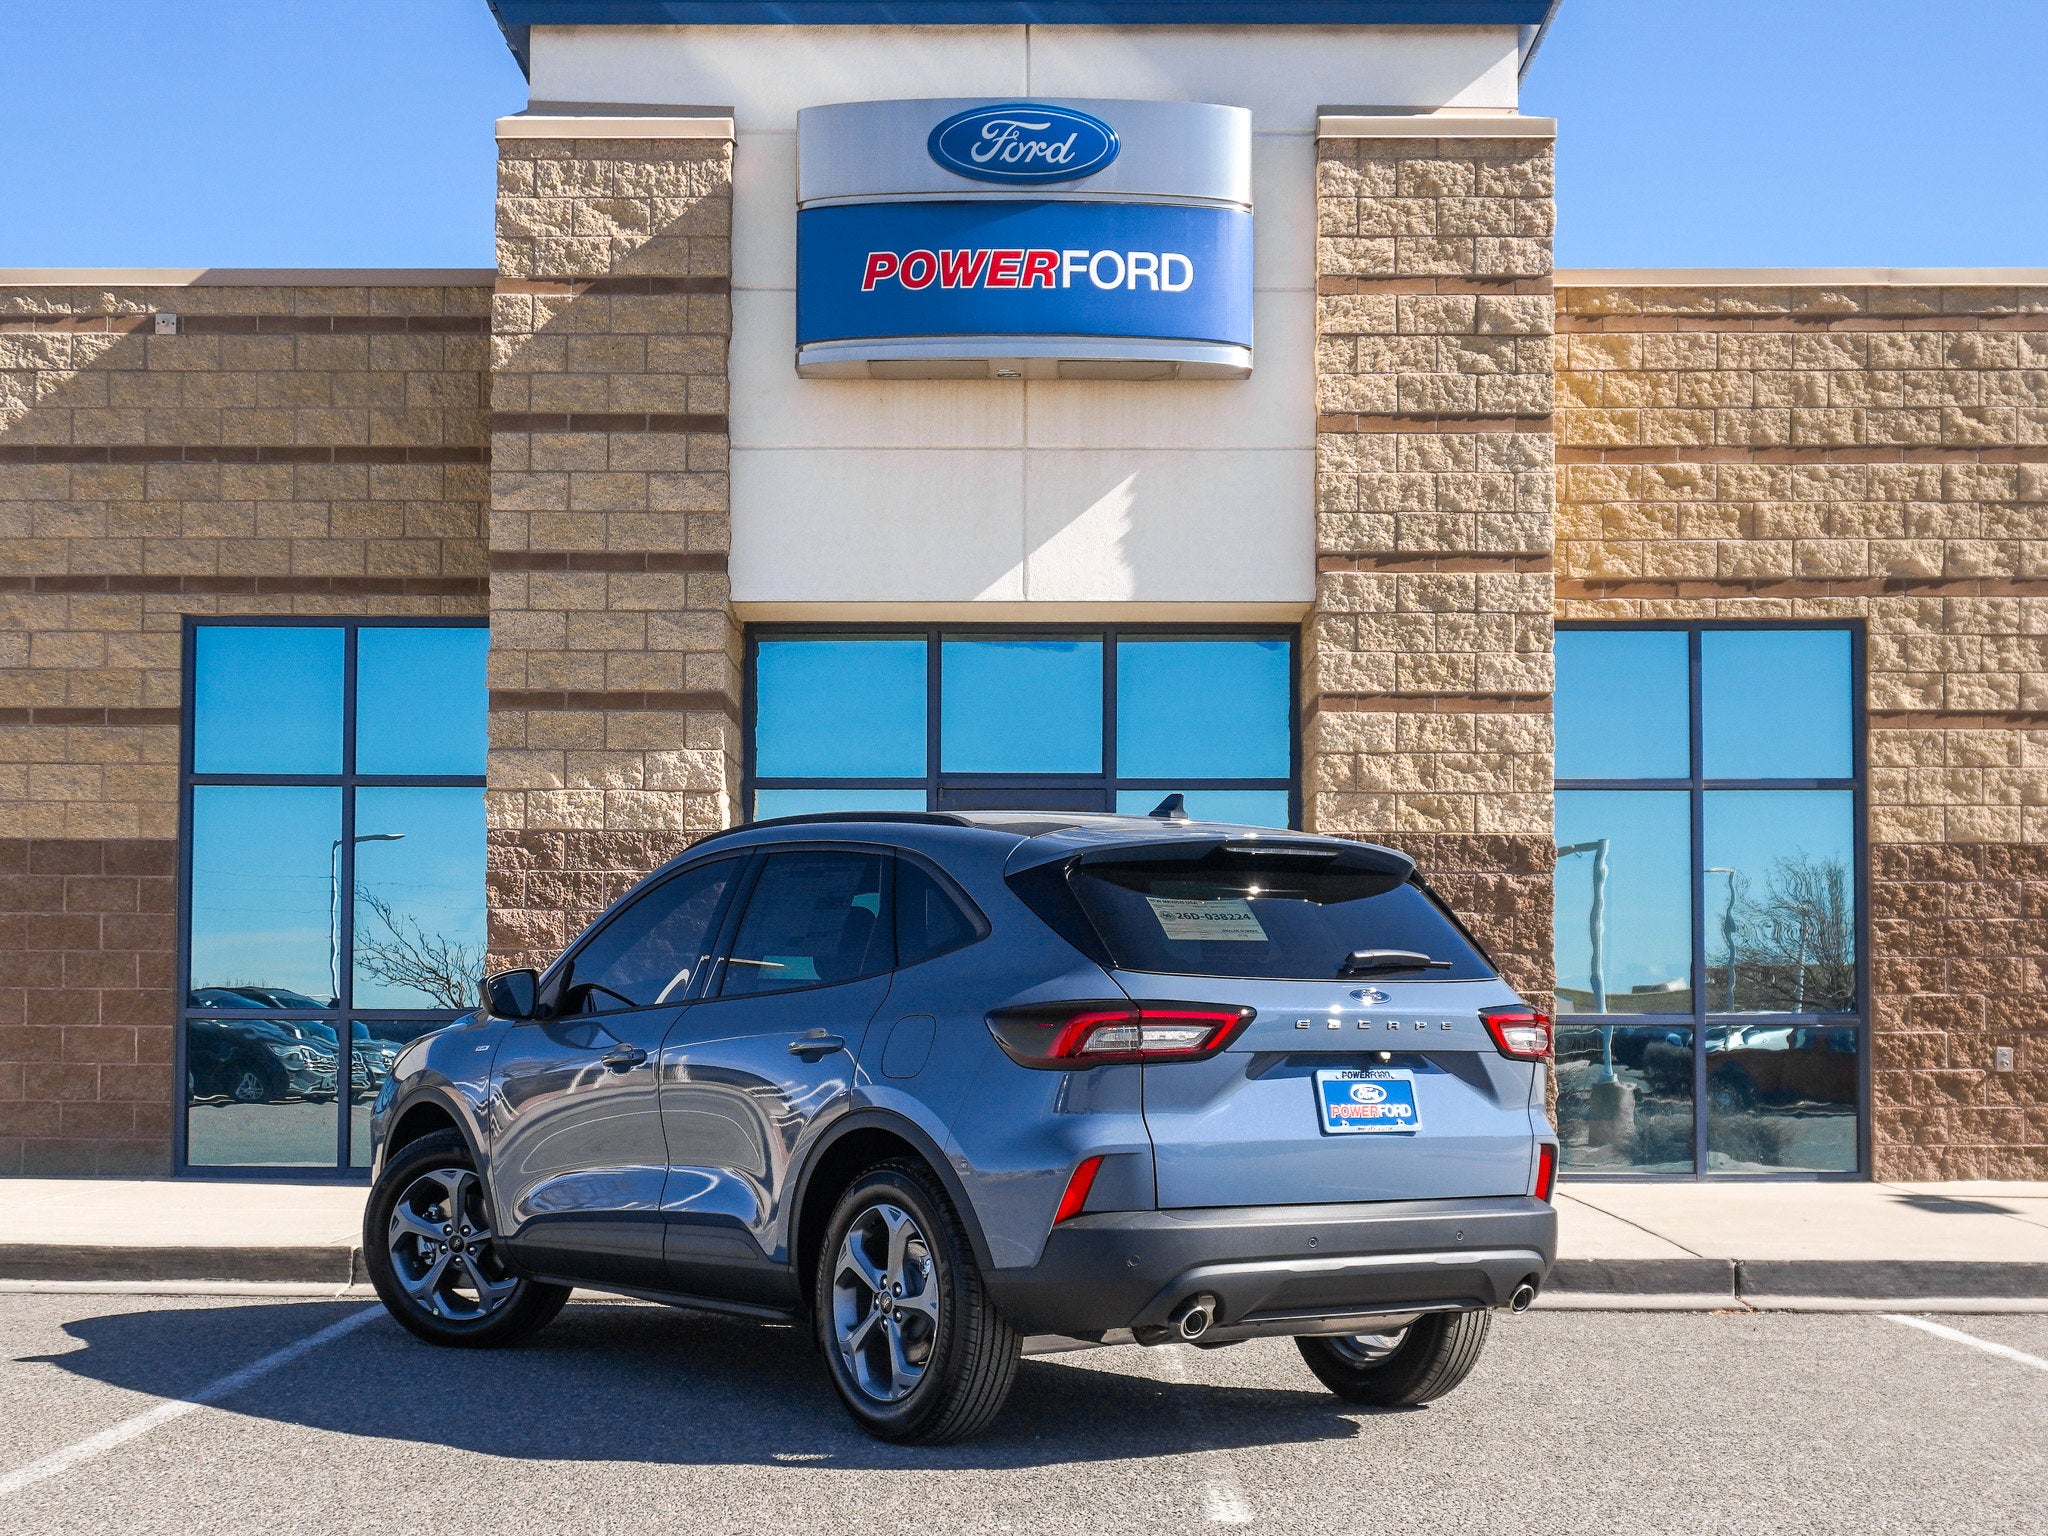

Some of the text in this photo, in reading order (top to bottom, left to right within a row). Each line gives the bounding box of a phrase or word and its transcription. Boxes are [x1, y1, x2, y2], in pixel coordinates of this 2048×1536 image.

[970, 119, 1079, 165] Ford
[861, 248, 1194, 292] POWERFORD
[1175, 912, 1251, 921] 26D-038224
[1295, 1018, 1453, 1030] ESCAPE
[1331, 1103, 1412, 1118] POWERFORD
